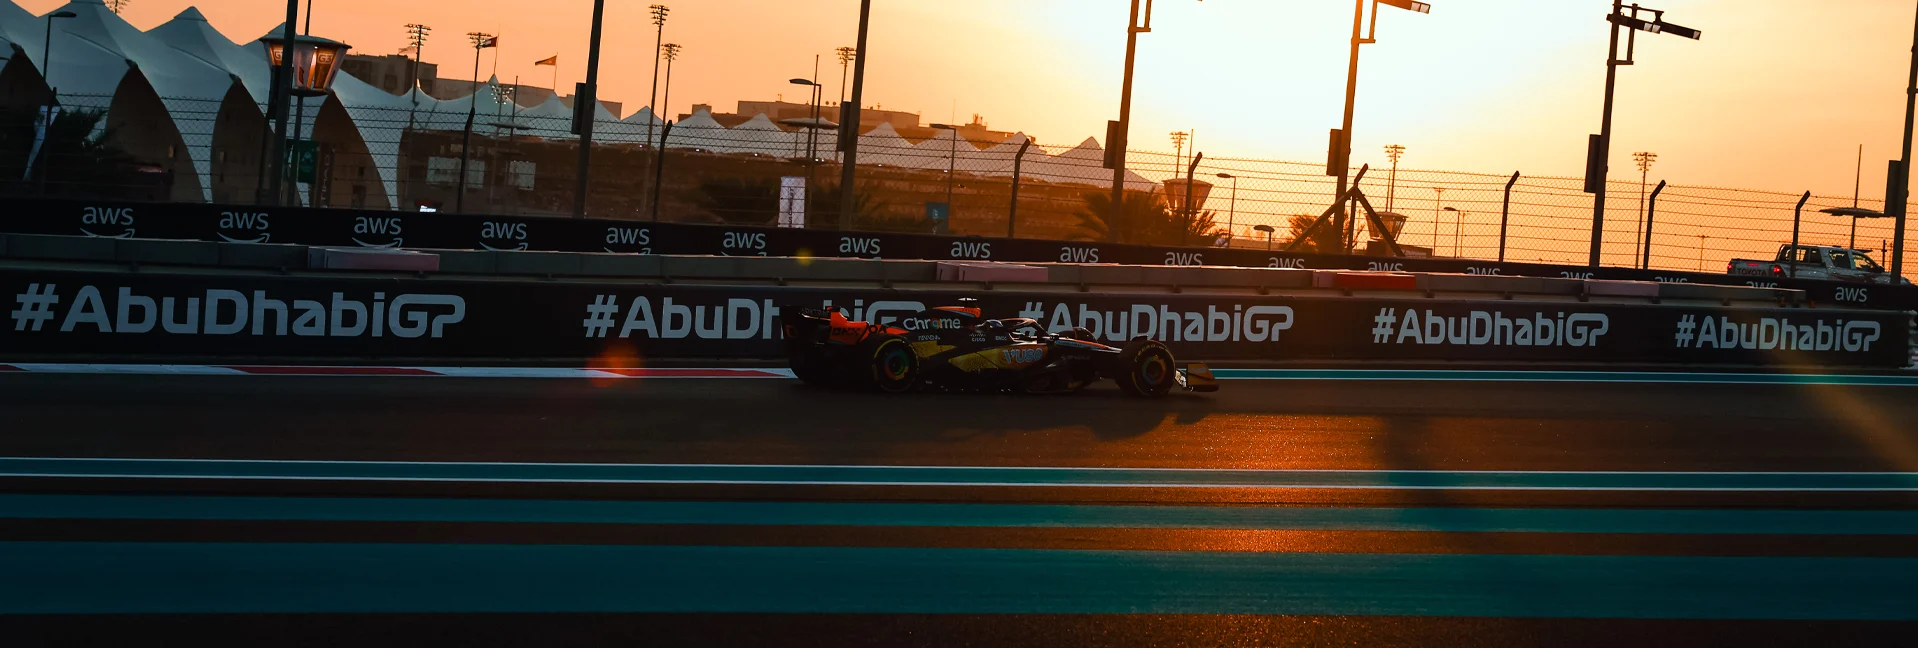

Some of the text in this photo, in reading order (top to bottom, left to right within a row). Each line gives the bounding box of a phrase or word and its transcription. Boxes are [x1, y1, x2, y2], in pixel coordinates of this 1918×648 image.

[82, 206, 134, 226] aws
[219, 211, 270, 230] aws
[354, 216, 402, 235] aws
[480, 220, 527, 240] aws
[605, 226, 650, 245] aws
[722, 231, 766, 250] aws
[839, 236, 881, 255] aws
[950, 241, 991, 259] aws
[1059, 246, 1099, 263] aws
[1164, 251, 1203, 267] aws
[1268, 257, 1305, 269] aws
[1737, 267, 1767, 276] TOYOTA
[1835, 287, 1867, 303] aws
[11, 283, 466, 338] #AbuDhabiGP
[903, 317, 961, 331] Chrome
[1015, 301, 1294, 343] #AbuDhabiGP
[1372, 307, 1609, 347] #AbuDhabiGP
[1675, 315, 1881, 352] #AbuDhabiGP
